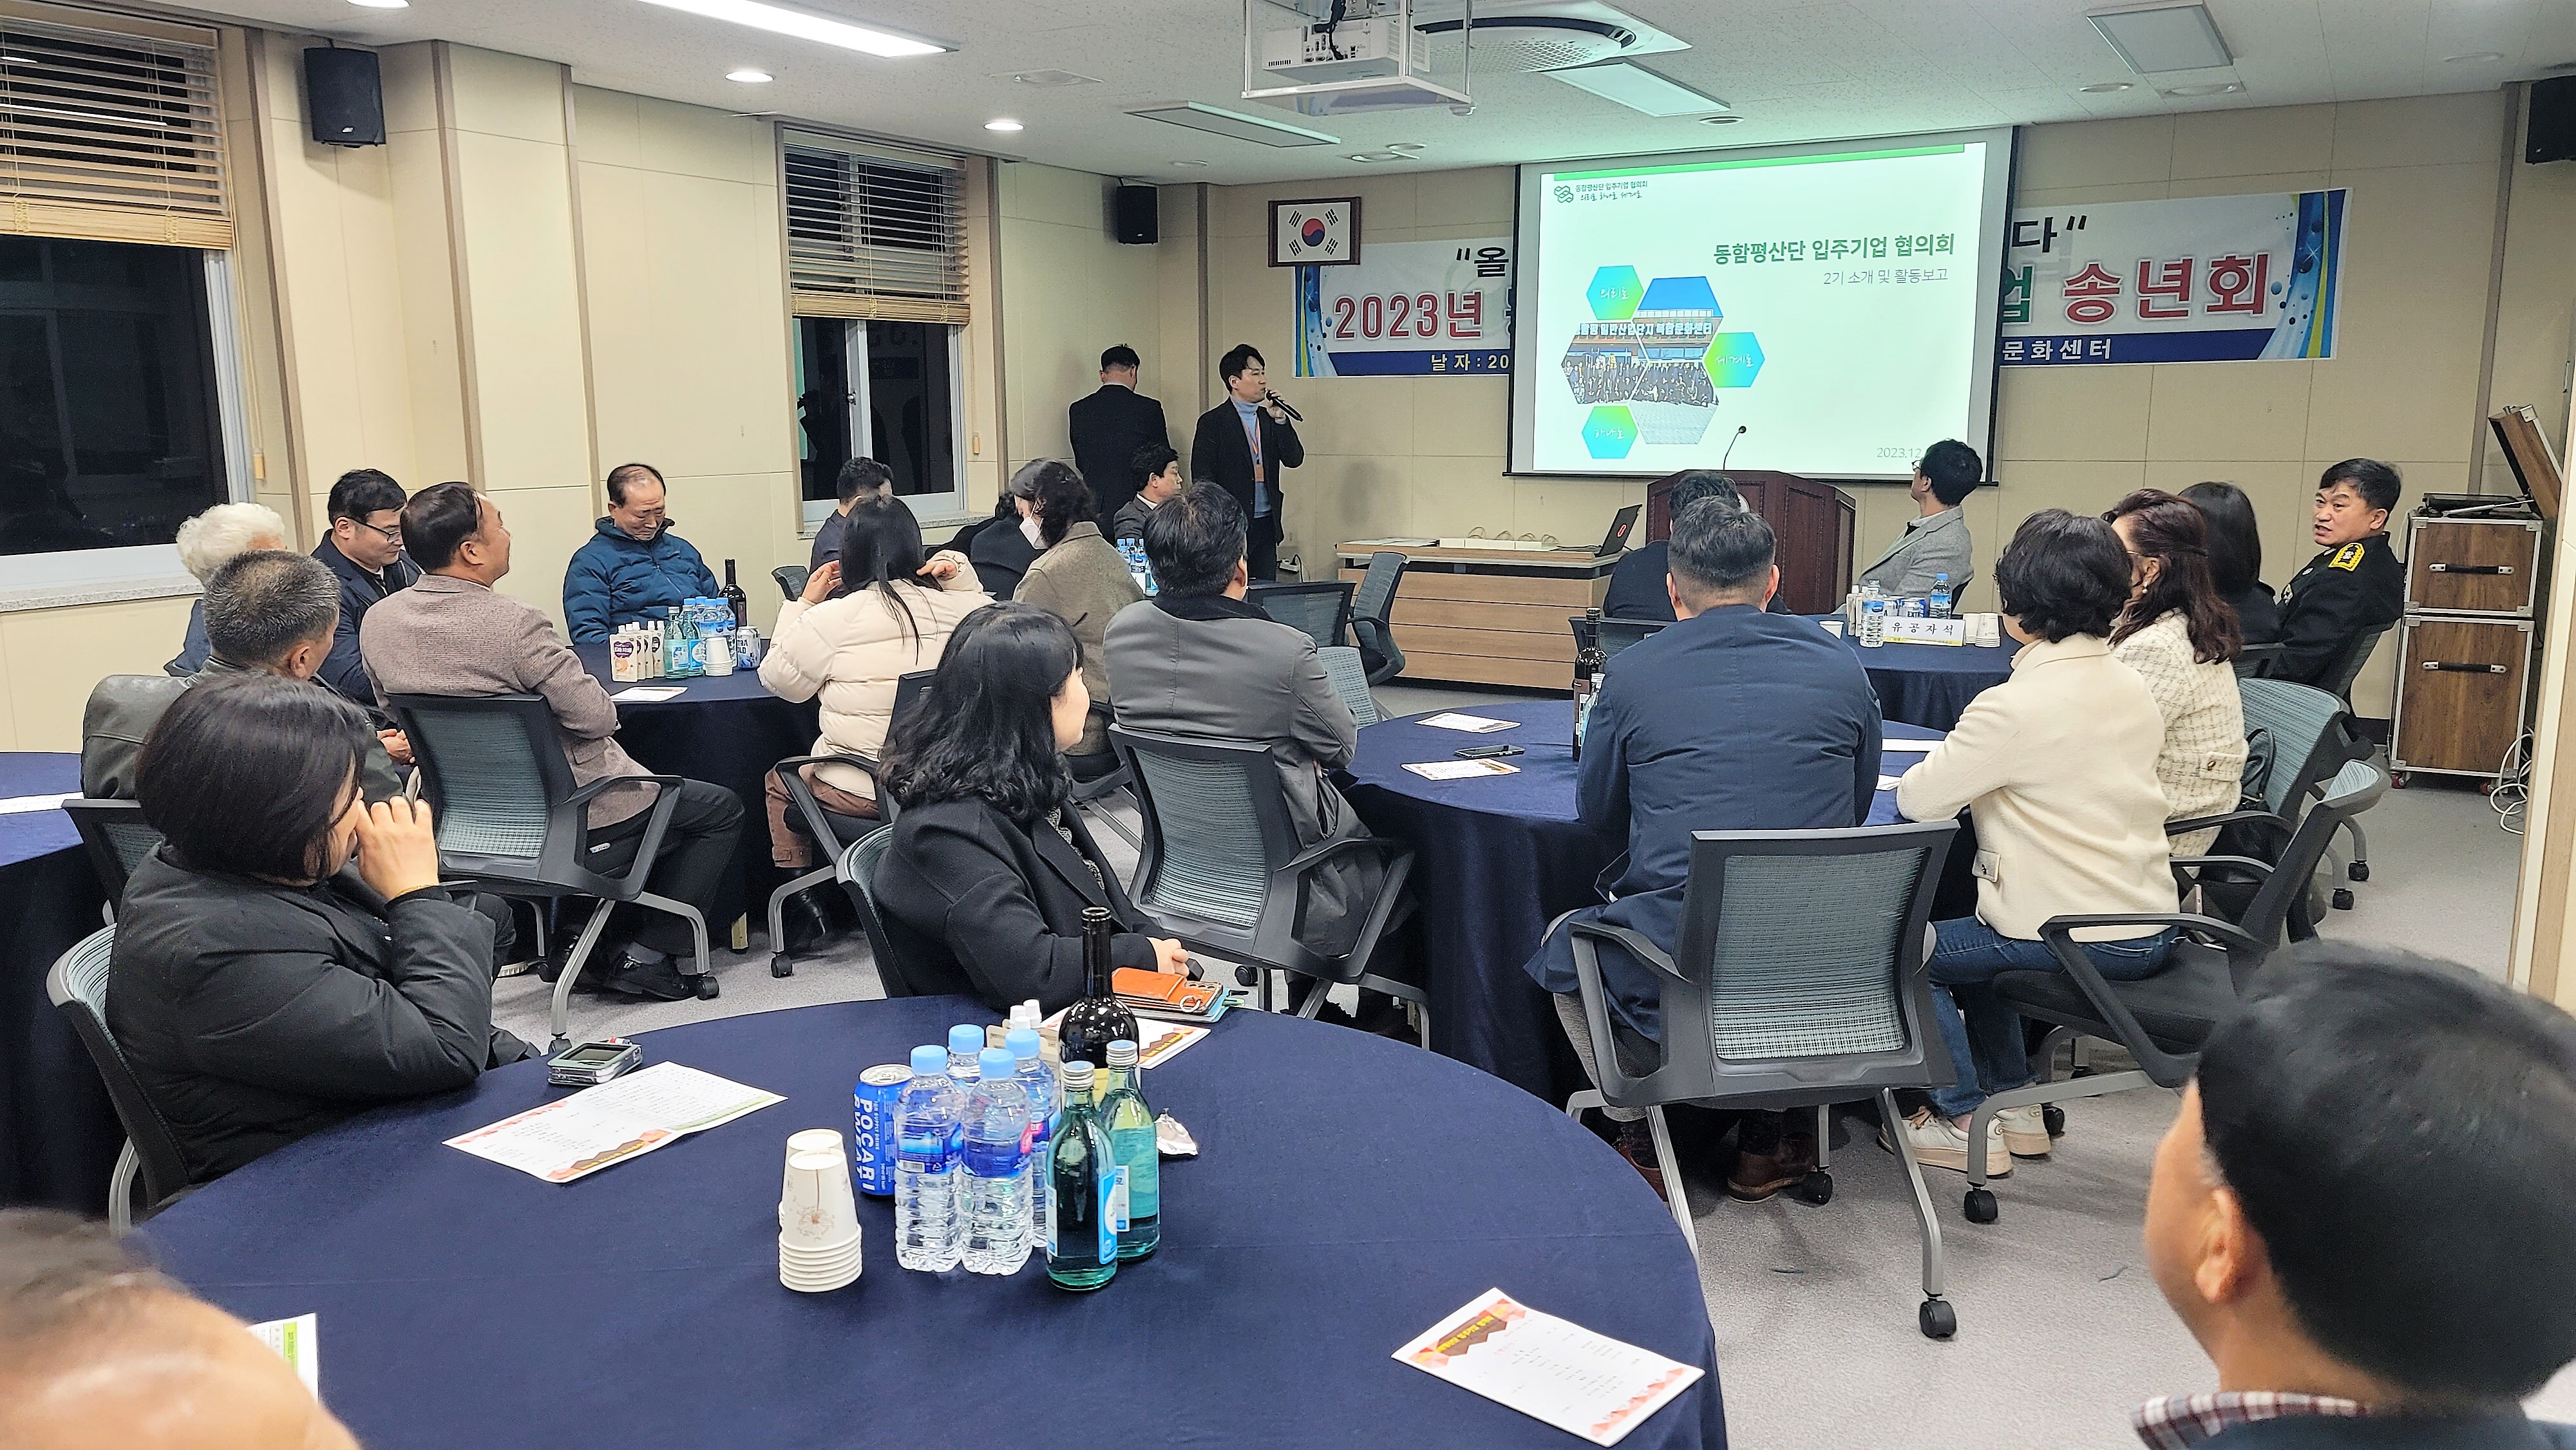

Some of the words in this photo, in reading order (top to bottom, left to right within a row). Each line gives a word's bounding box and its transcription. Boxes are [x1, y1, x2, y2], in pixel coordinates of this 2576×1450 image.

[1713, 240, 1806, 265] 동함평산단
[1812, 236, 1888, 261] 입주기업
[1894, 233, 1955, 257] 협의회
[1823, 270, 1844, 285] 2기
[1847, 269, 1874, 284] 소개
[1878, 268, 1889, 284] 및
[1894, 268, 1948, 284] 활동보고
[2063, 253, 2269, 324] 송년회
[1334, 290, 1483, 340] 2023년
[2002, 338, 2112, 361] 문화센터
[859, 1098, 875, 1191] POCARI
